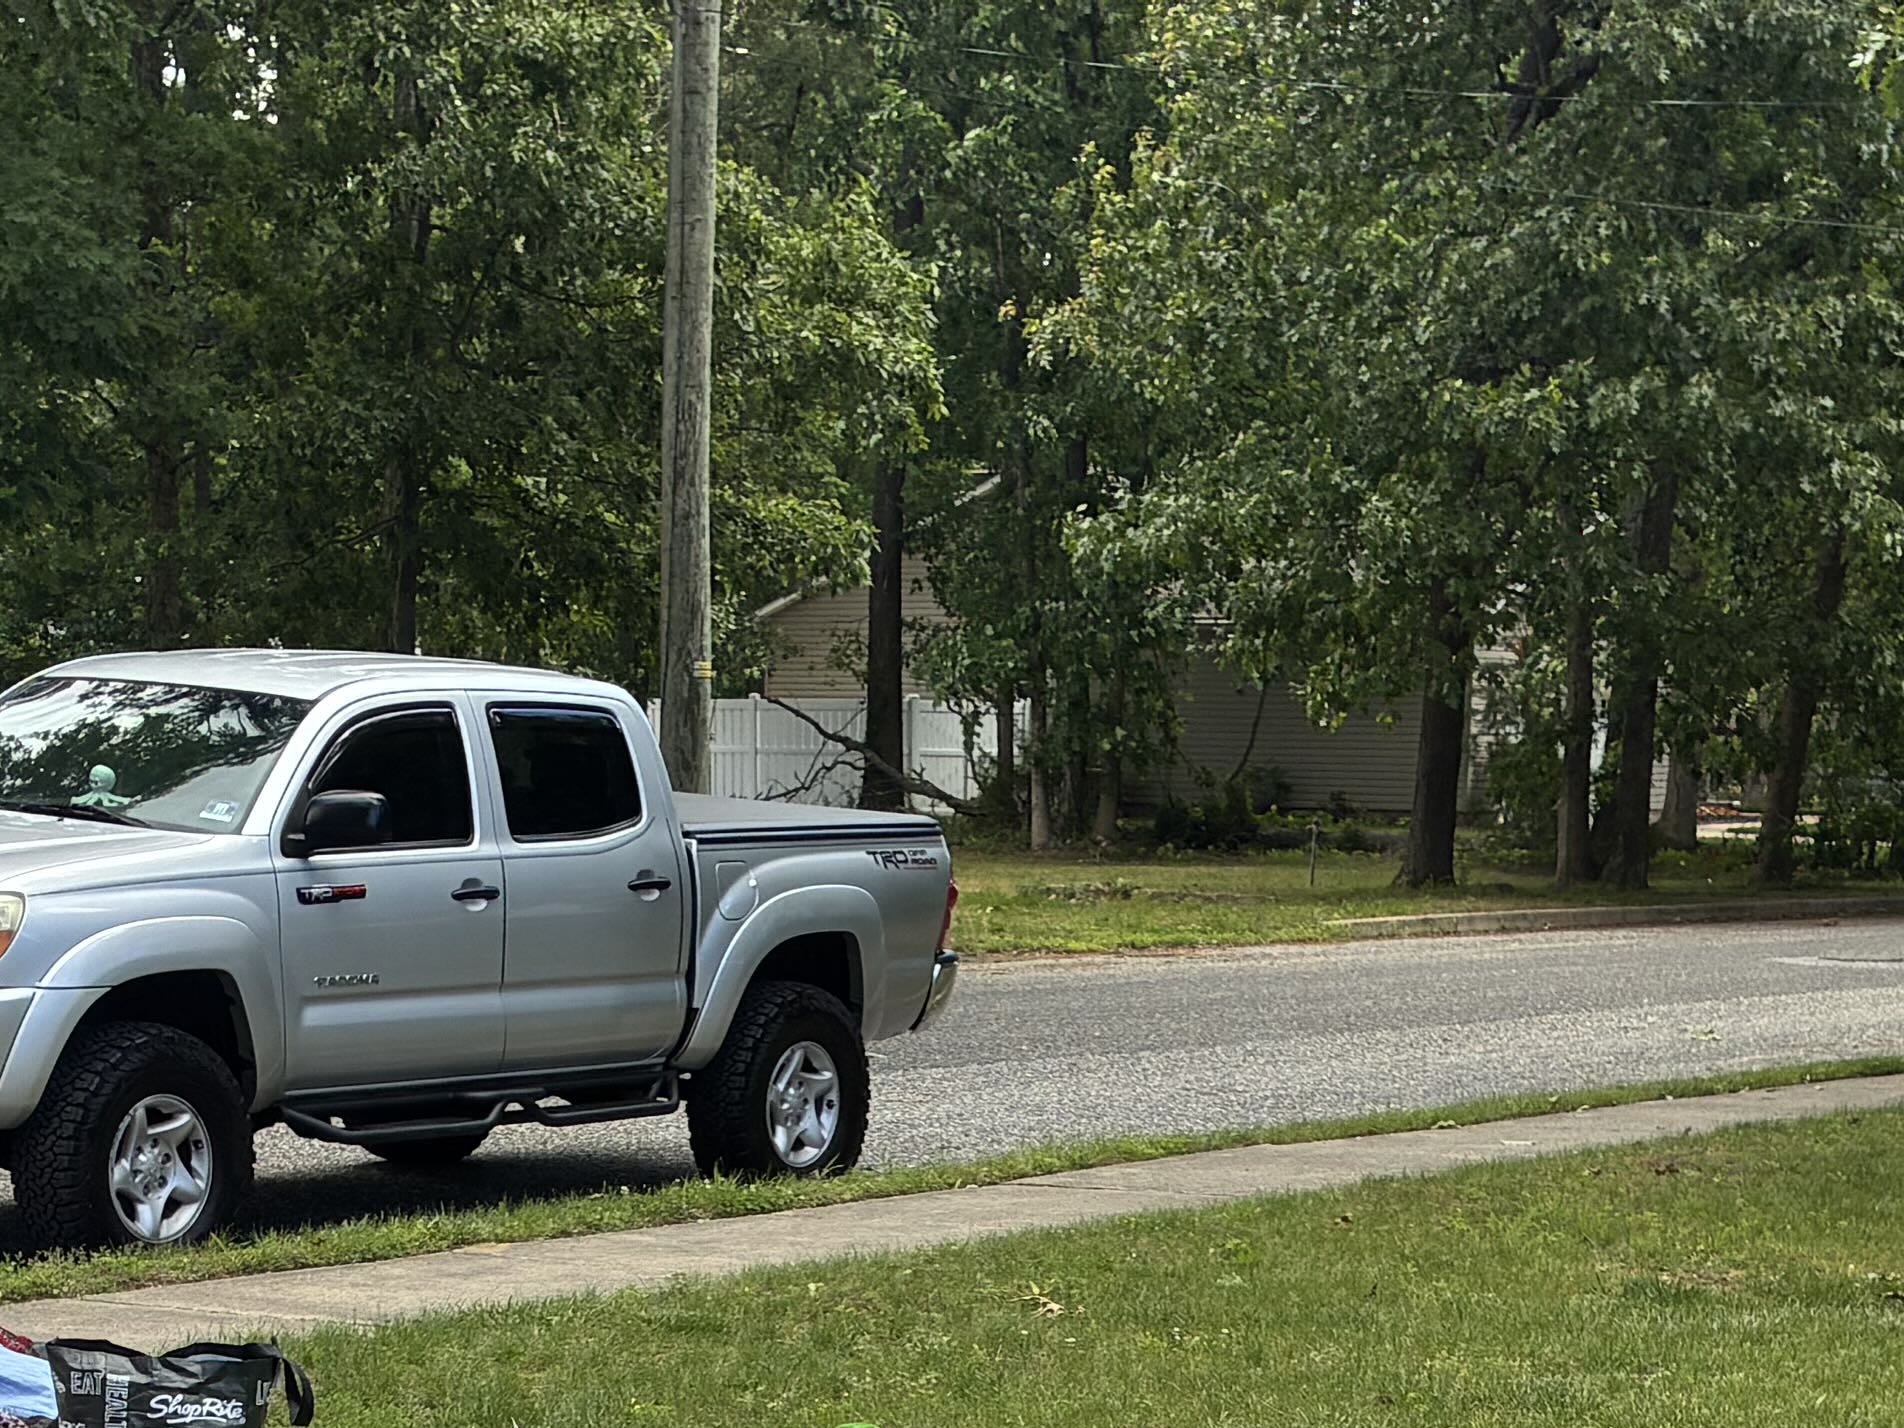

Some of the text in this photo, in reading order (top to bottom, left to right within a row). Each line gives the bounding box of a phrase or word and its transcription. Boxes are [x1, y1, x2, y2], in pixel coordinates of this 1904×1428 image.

[865, 850, 909, 870] TRD
[70, 1369, 105, 1395] EAT
[147, 1394, 244, 1423] ShopRite
